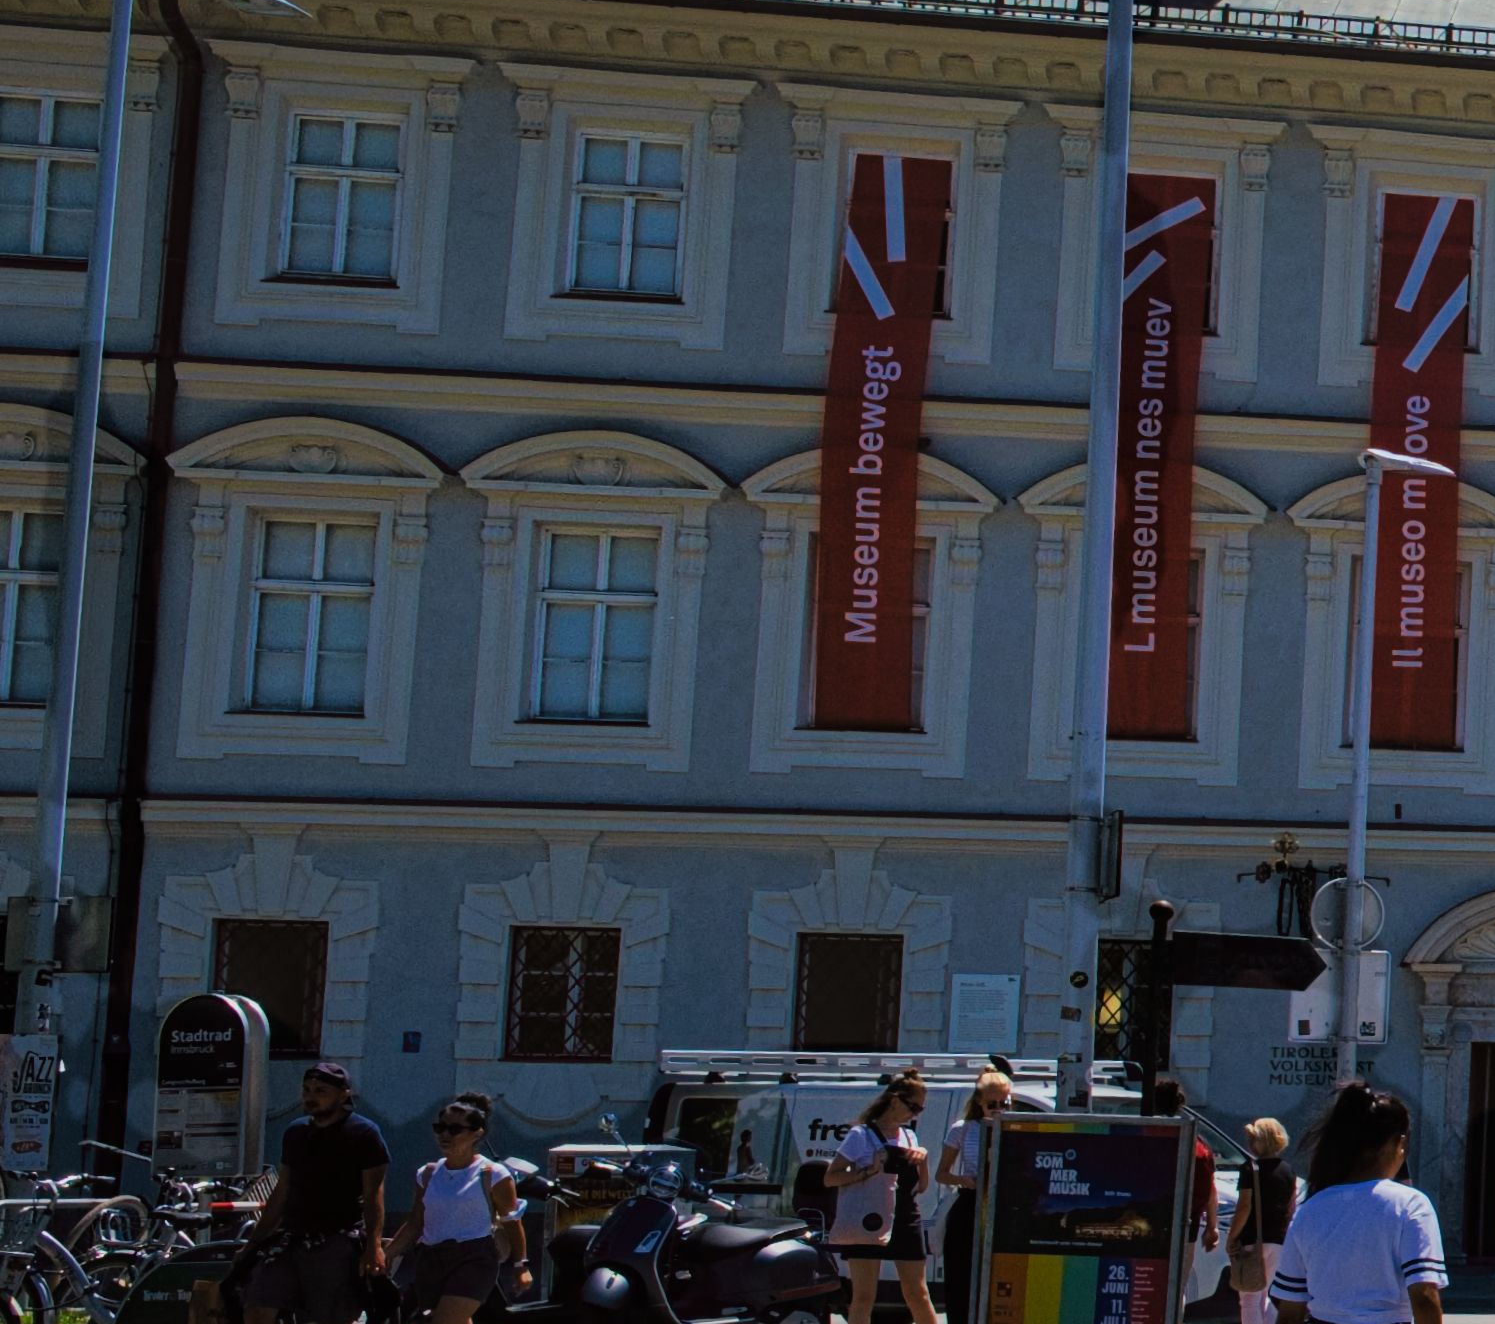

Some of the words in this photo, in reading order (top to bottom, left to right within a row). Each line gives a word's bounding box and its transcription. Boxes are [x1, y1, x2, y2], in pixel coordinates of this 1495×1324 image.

[1141, 297, 1174, 389] muev
[849, 344, 901, 475] bewegt
[1136, 397, 1164, 460] nes
[1402, 394, 1431, 510] move
[1132, 470, 1160, 625] museum
[844, 487, 882, 643] Museum
[1400, 519, 1427, 637] museo
[1124, 632, 1155, 652] L
[1391, 647, 1424, 668] Il
[170, 1028, 232, 1043] Stadtrad
[170, 1044, 216, 1055] Innsbruck
[12, 1051, 55, 1094] JAZZ
[1035, 1155, 1064, 1169] SOM
[1049, 1169, 1078, 1182] MER
[1048, 1182, 1090, 1196] MUSIK
[1108, 1264, 1130, 1281] 26.
[1101, 1281, 1129, 1295] JUNI
[1110, 1299, 1127, 1315] 11.
